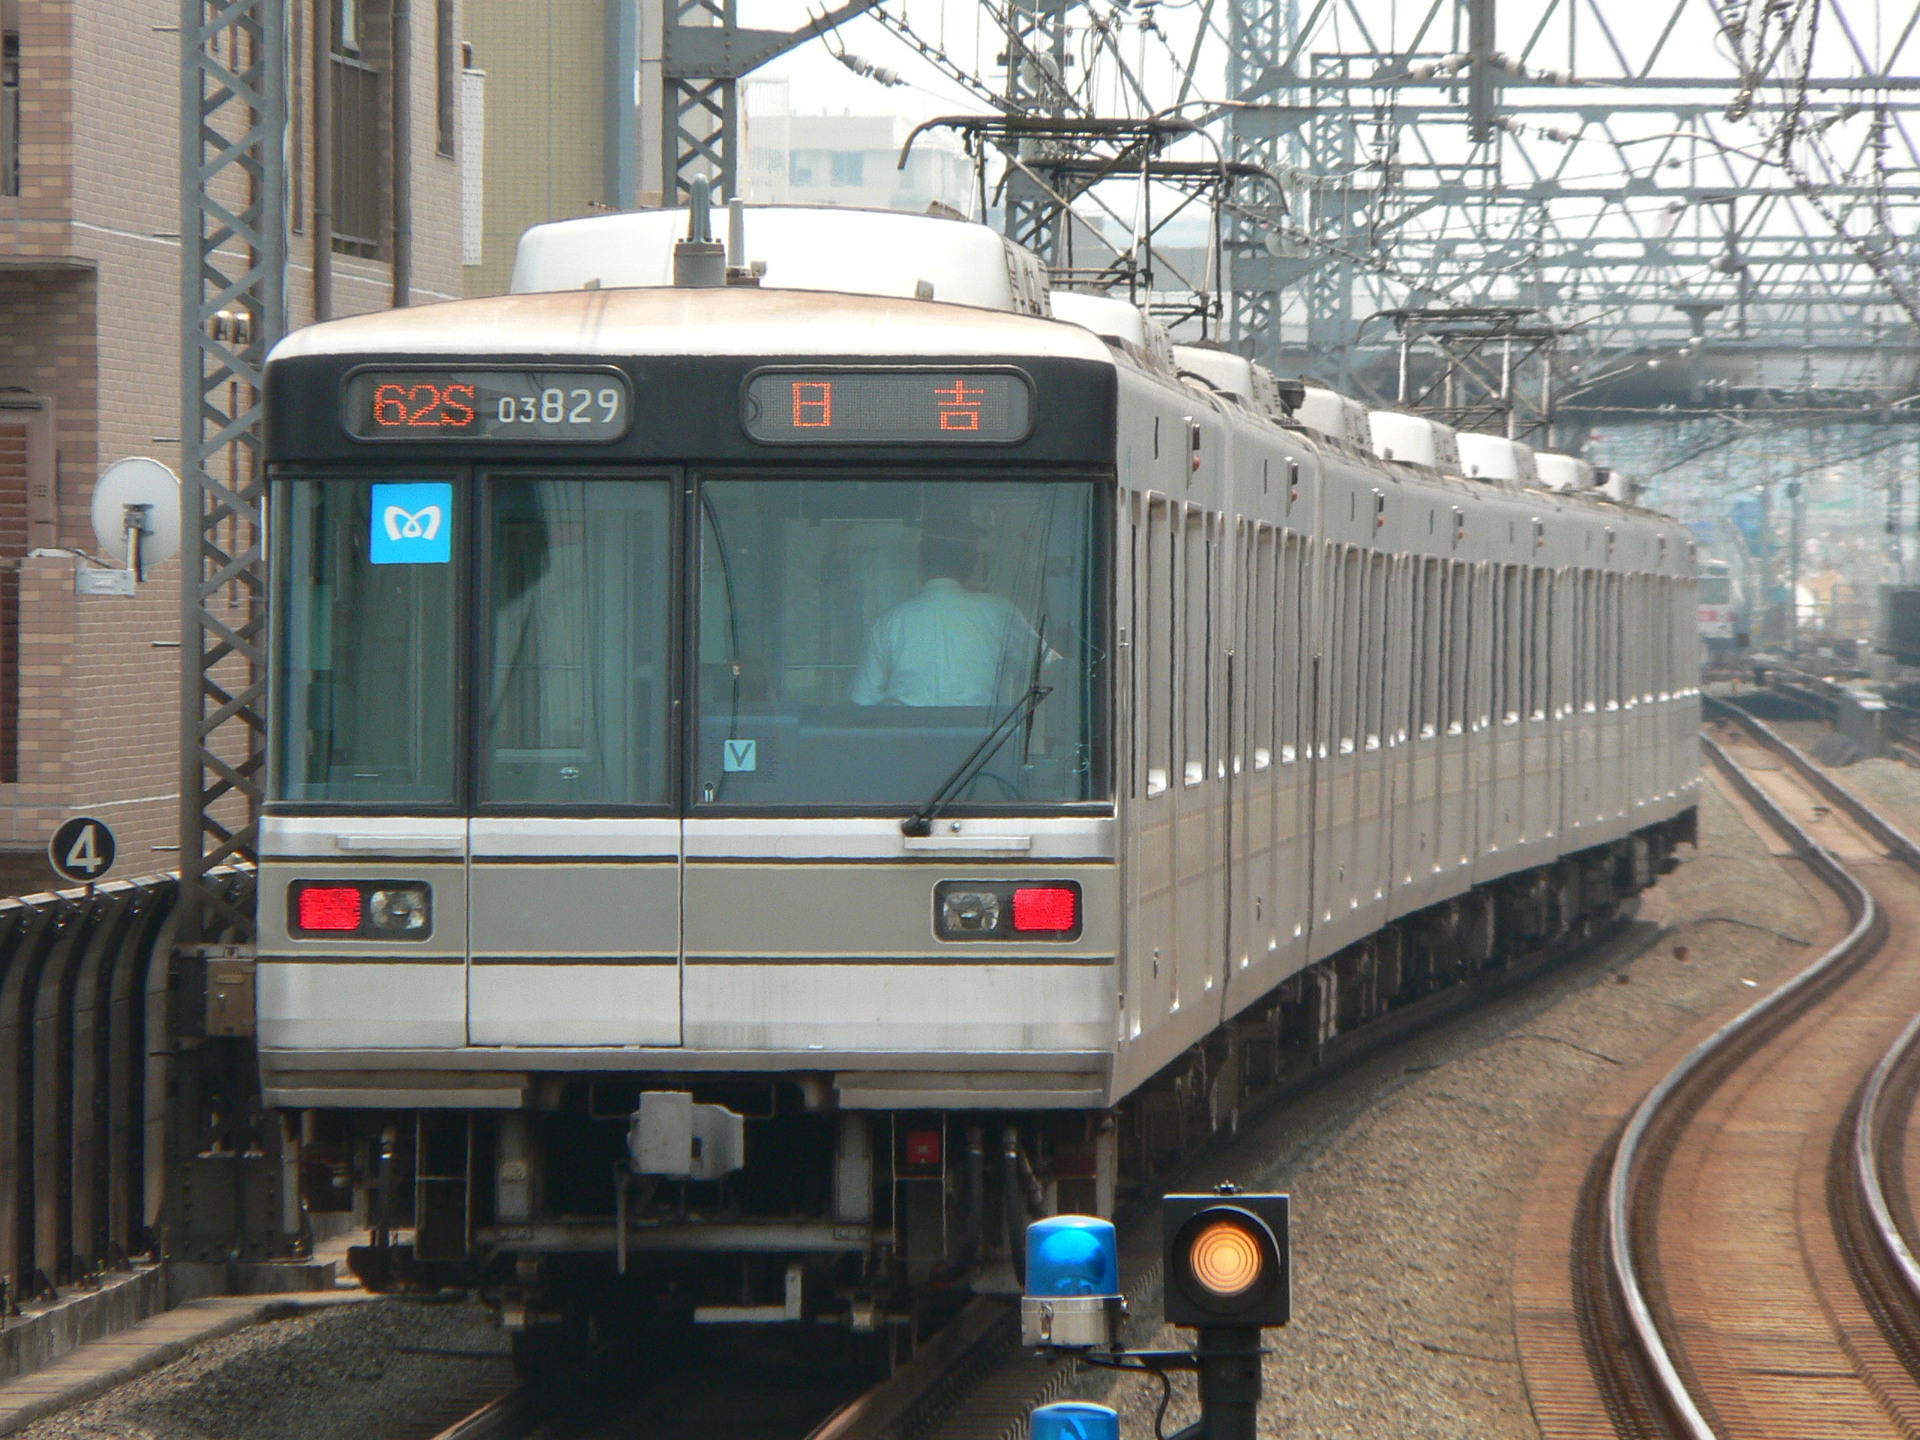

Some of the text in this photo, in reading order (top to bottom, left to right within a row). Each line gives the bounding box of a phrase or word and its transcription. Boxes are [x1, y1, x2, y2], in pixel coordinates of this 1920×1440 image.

[373, 384, 619, 426] 62S 03829
[729, 743, 753, 768] V
[66, 825, 102, 873] 4
